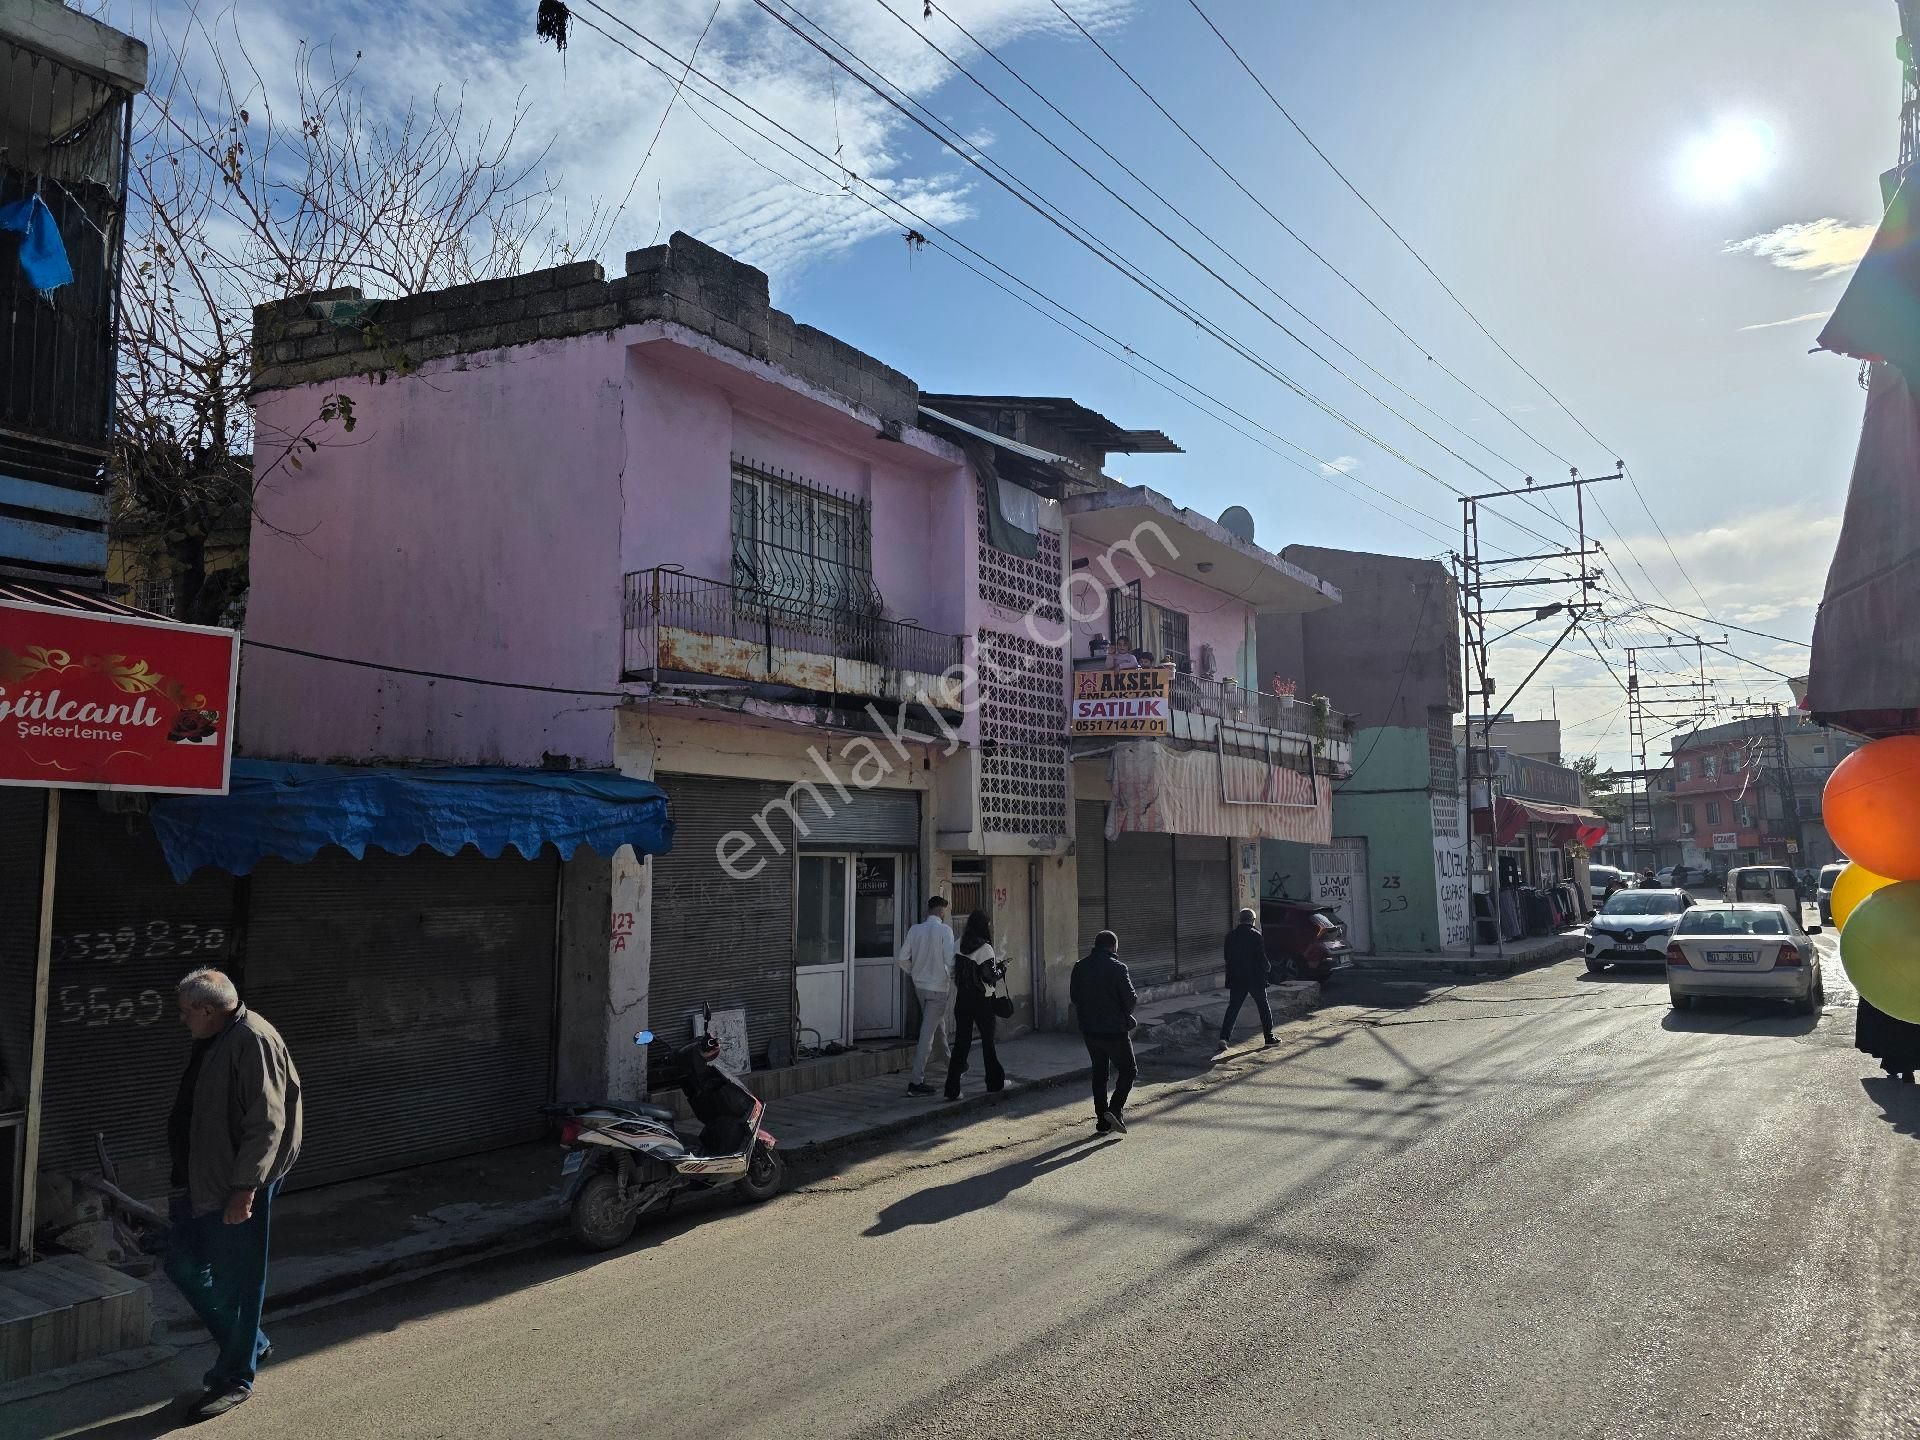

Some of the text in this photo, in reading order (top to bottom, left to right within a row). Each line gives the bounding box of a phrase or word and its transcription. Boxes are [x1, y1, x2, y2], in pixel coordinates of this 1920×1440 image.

[1100, 672, 1164, 692] AKSEL
[1078, 690, 1163, 700] EMLAK'TAN
[1078, 701, 1162, 718] SATILIK
[16, 721, 124, 741] Şekerleme
[1075, 719, 1164, 732] 0551 714 47 01
[856, 880, 889, 890] ERSHOP
[1382, 876, 1401, 889] 23
[1380, 895, 1408, 914] 23
[612, 911, 635, 929] 127
[144, 919, 225, 957] 830
[614, 936, 626, 953] A
